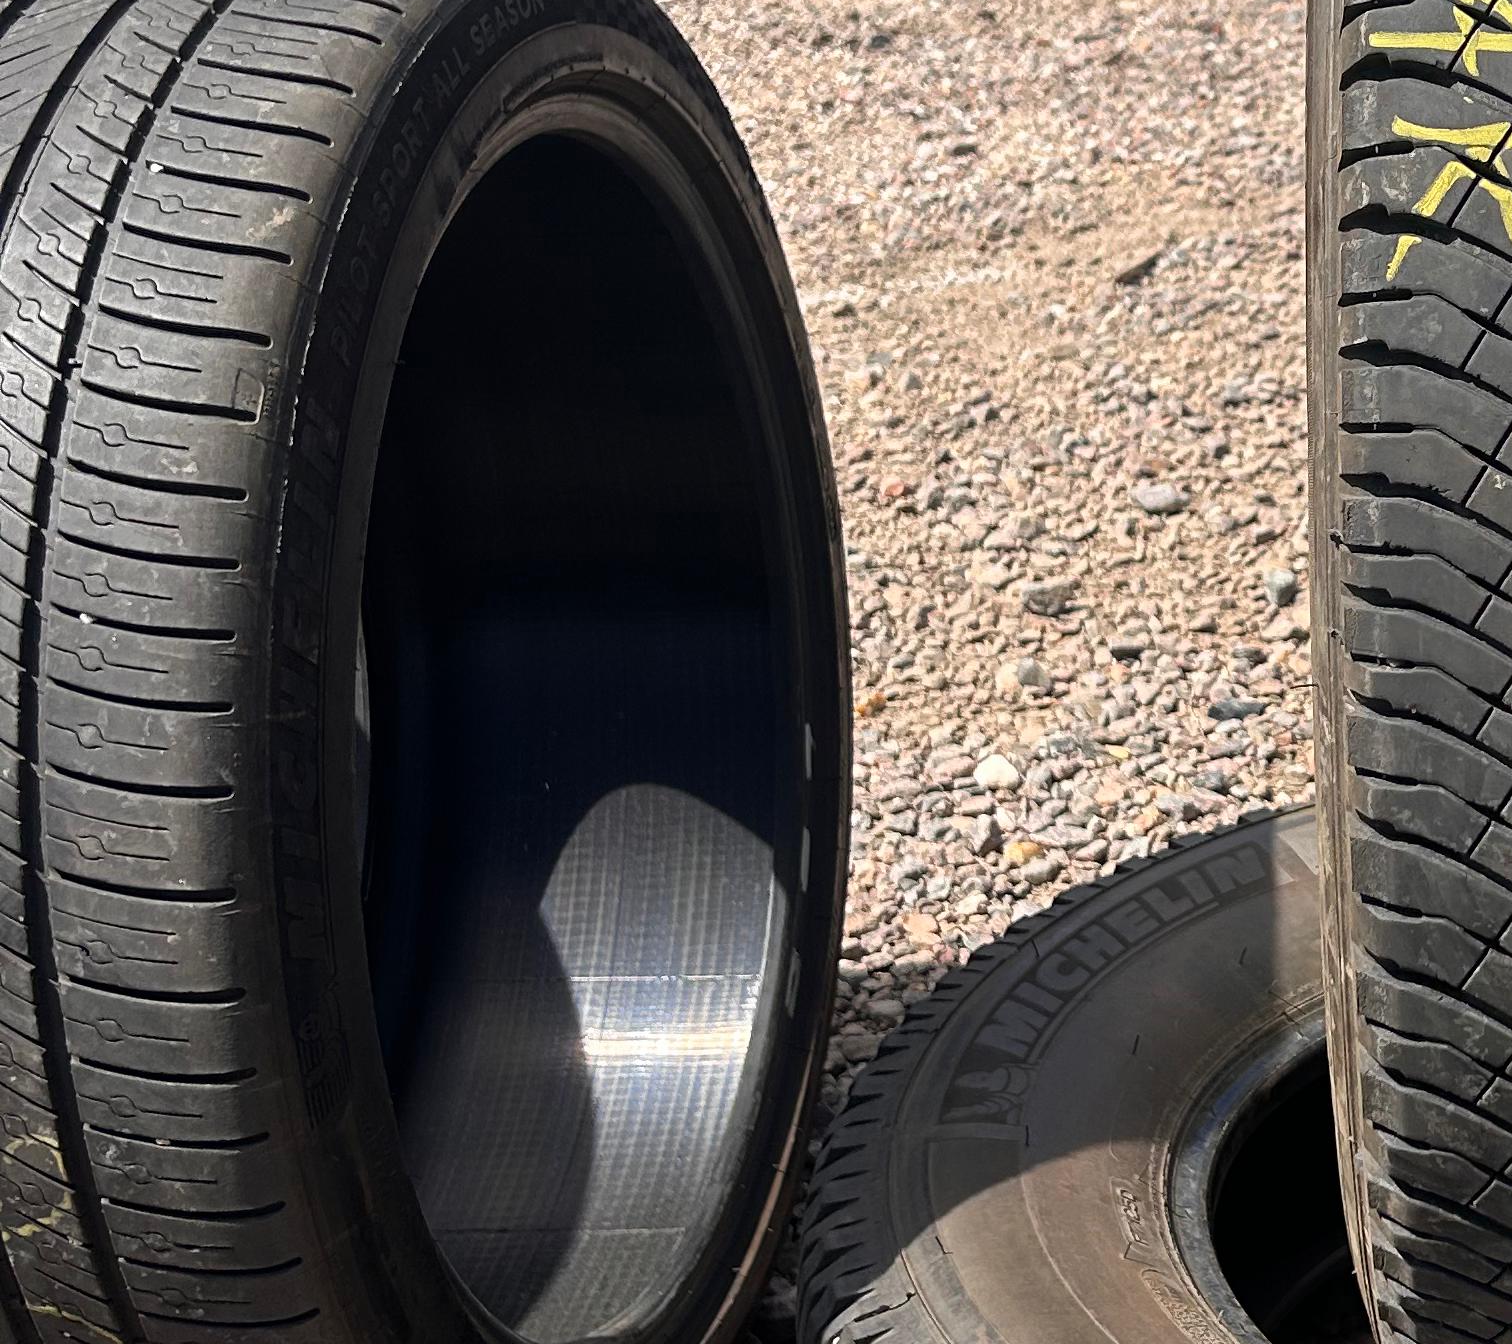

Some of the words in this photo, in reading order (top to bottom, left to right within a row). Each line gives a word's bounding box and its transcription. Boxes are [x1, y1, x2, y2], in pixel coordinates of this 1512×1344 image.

[330, 223, 378, 367] PILOT
[372, 97, 433, 225] SPORT
[432, 54, 472, 108] ALL
[976, 847, 1268, 1056] MICHELIN
